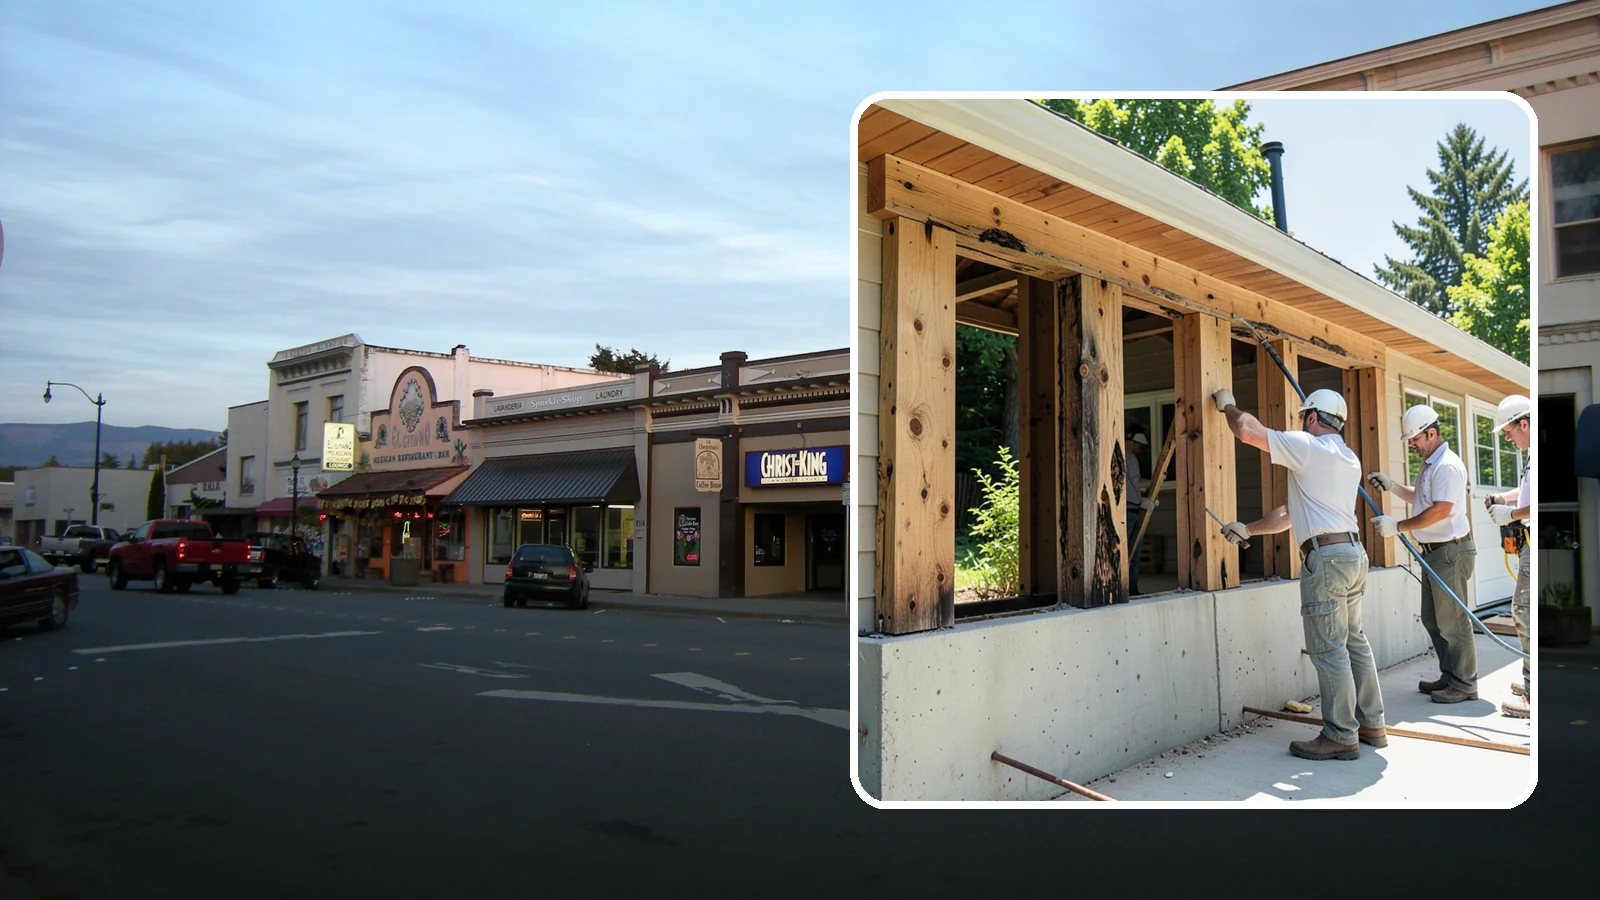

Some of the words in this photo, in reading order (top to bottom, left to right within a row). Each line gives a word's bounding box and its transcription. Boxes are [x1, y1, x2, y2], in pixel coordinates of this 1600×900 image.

[560, 394, 582, 406] Shop
[596, 389, 624, 400] LAUNDRY
[494, 402, 523, 412] LAVANDERIA
[374, 454, 396, 464] MEXICAN
[398, 451, 434, 462] RESTAURANT
[438, 450, 450, 458] BAR
[760, 452, 797, 478] CHRIST
[799, 450, 827, 476] KING
